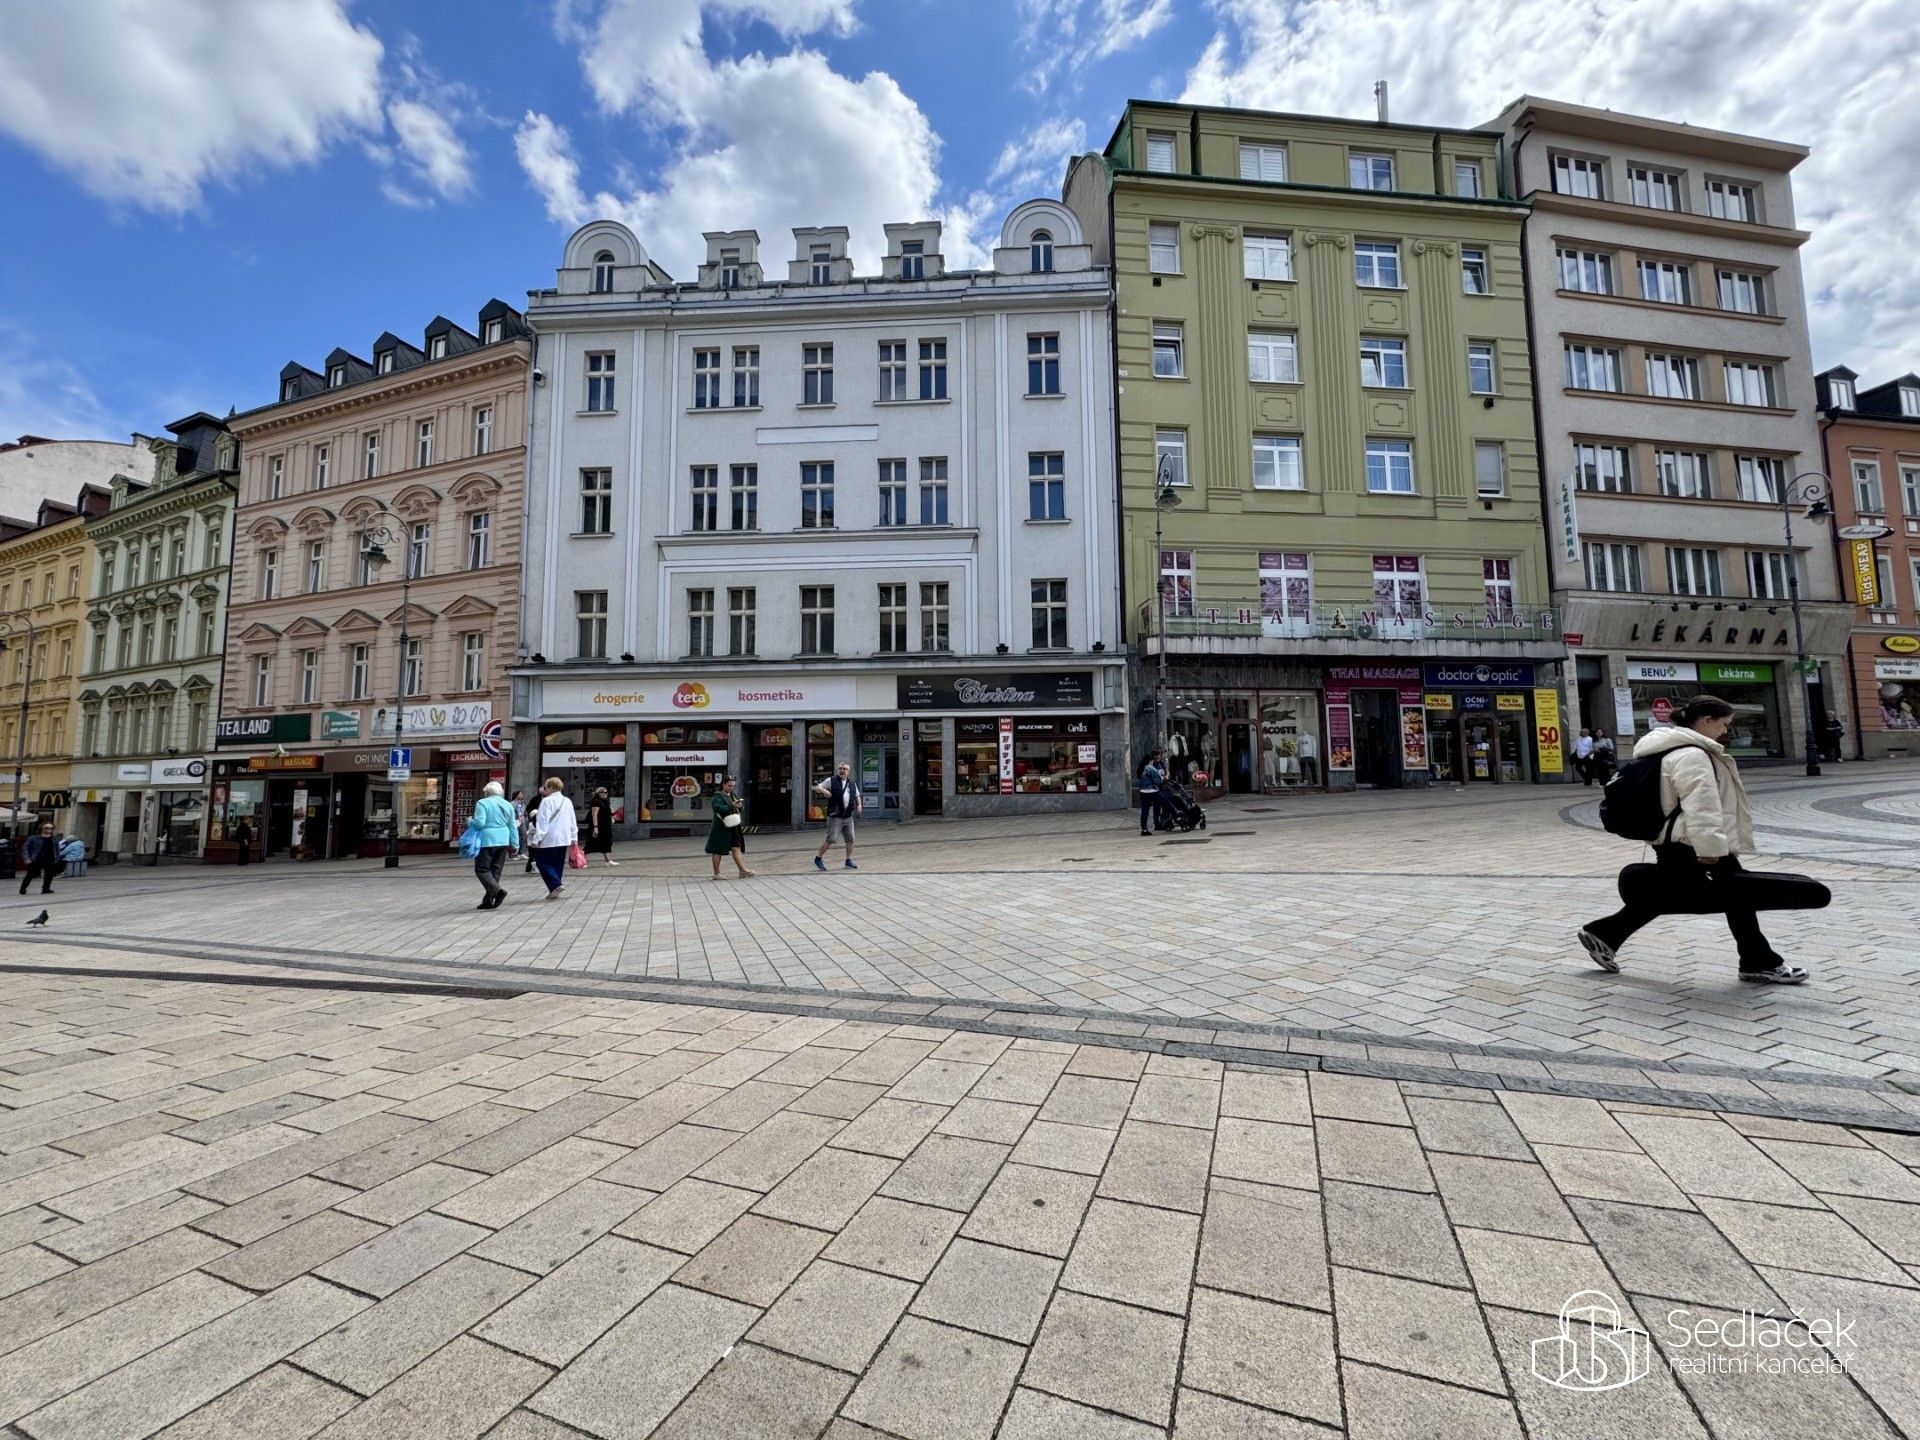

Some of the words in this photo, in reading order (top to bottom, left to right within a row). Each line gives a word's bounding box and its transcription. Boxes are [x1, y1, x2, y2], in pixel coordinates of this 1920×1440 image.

[1857, 541, 1871, 574] WEAR
[1861, 576, 1874, 601] Kids
[1206, 608, 1311, 626] THAI
[1360, 610, 1553, 630] MASSAGE
[1630, 619, 1788, 645] LÉKÁRNA
[1329, 667, 1360, 679] THAI
[1362, 667, 1420, 679] MASSAGE
[1438, 666, 1475, 681] doctor
[1641, 668, 1666, 677] BENU
[1718, 668, 1755, 679] Lékárna
[593, 692, 645, 706] drogerie
[677, 690, 706, 703] teta
[738, 689, 804, 702] kosmetika
[241, 719, 271, 735] LAND
[766, 734, 786, 743] teta
[1539, 726, 1559, 743] 50
[568, 754, 600, 763] drogerie
[665, 754, 705, 762] kosmetika
[675, 783, 696, 793] teta
